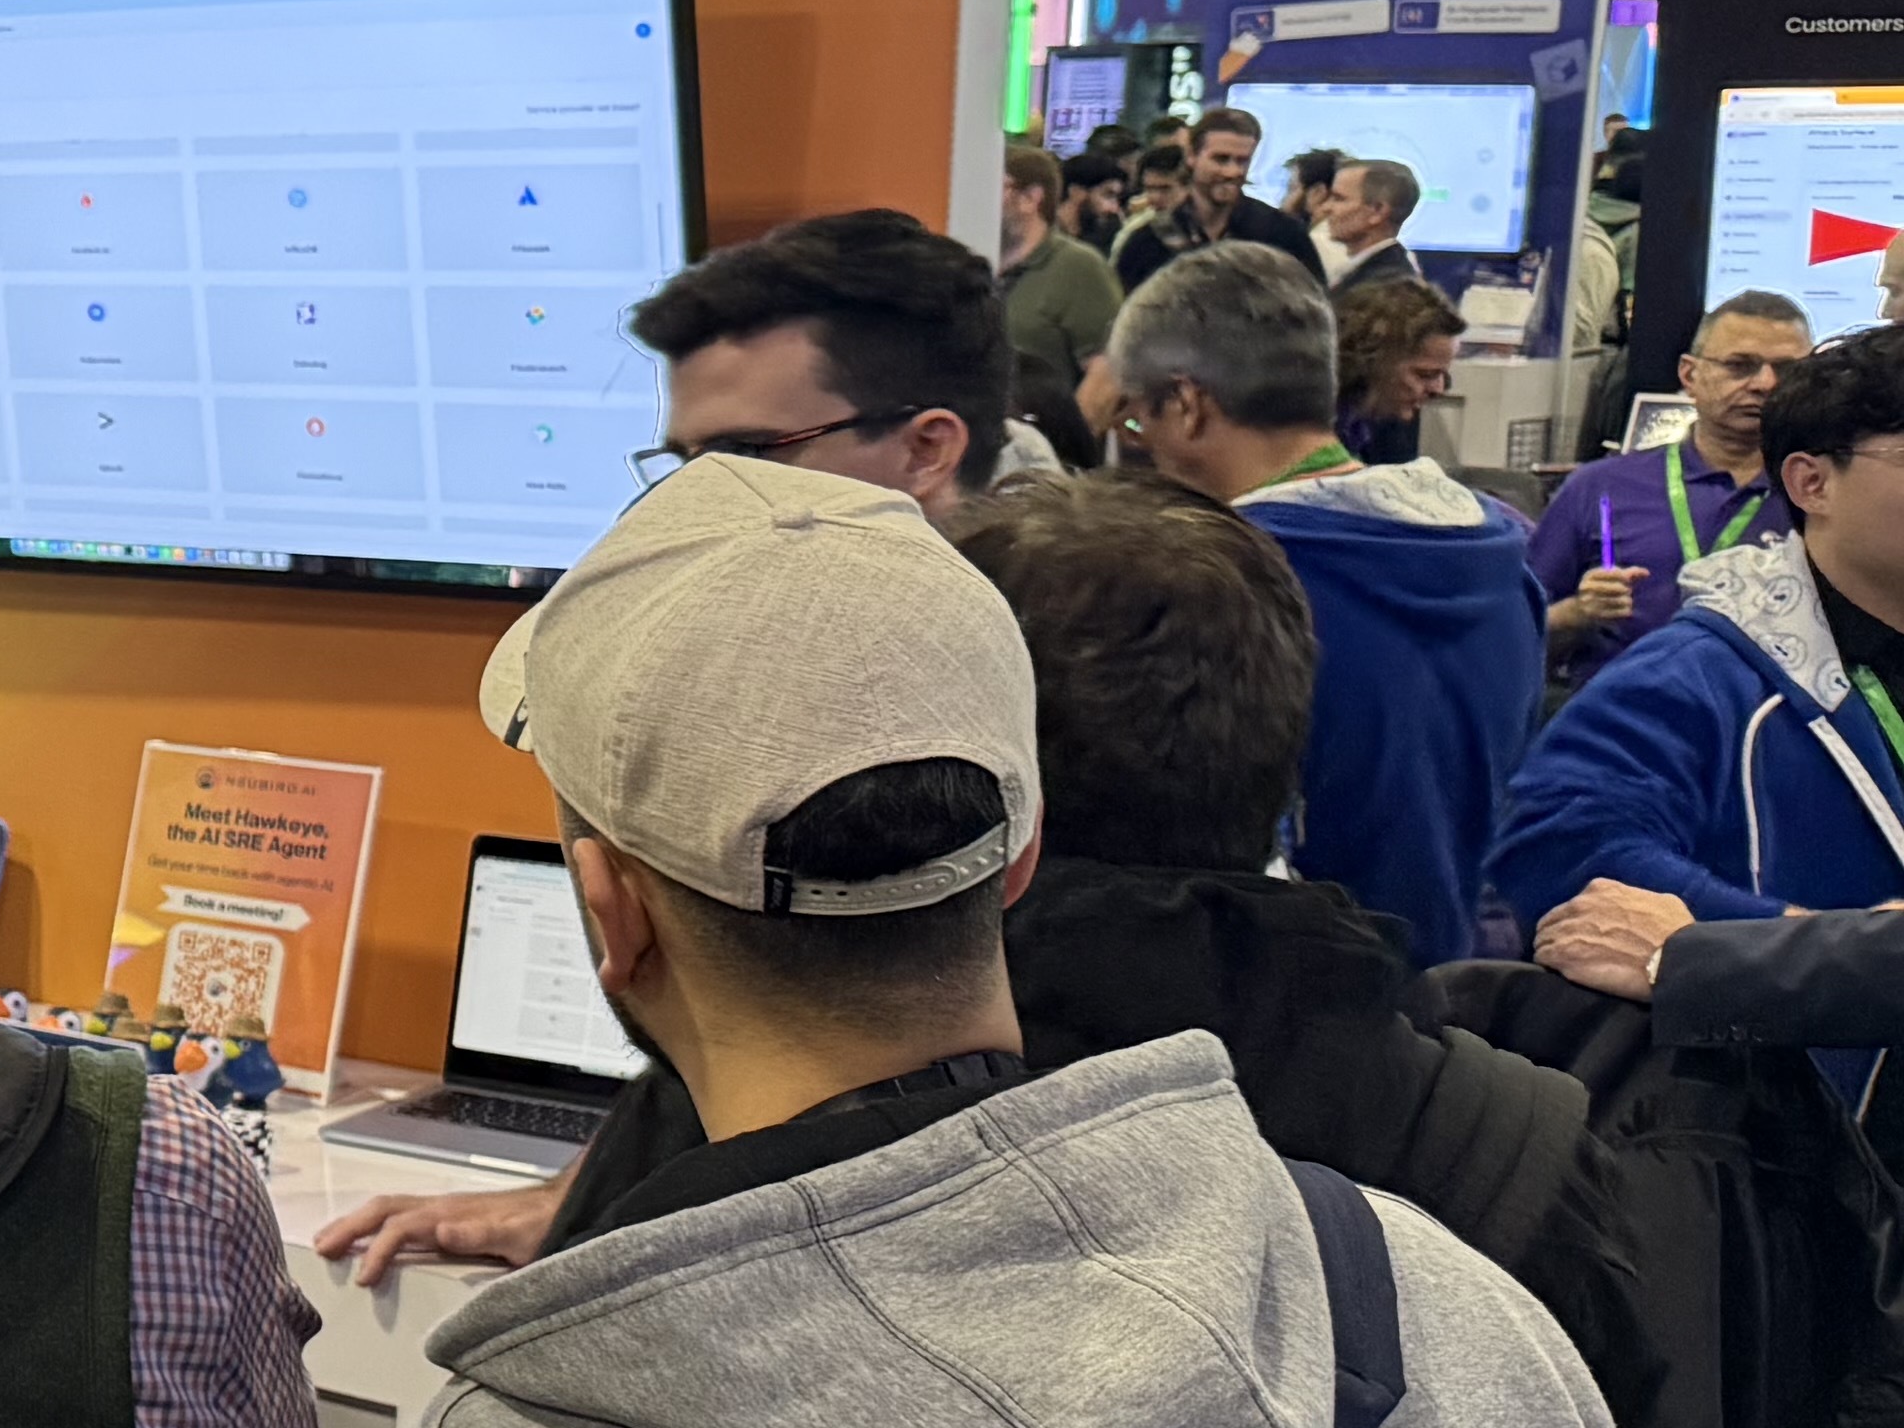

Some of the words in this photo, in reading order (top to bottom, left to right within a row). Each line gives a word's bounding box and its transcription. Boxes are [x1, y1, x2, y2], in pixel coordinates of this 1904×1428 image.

[1784, 14, 1904, 36] Customers
[184, 801, 232, 825] Meet
[234, 807, 330, 840] Hawkeye,
[166, 823, 198, 842] the
[198, 826, 220, 846] AI
[223, 828, 266, 852] SRE
[267, 835, 328, 861] Agent
[182, 892, 217, 911] Book
[226, 901, 285, 923] meeting!
